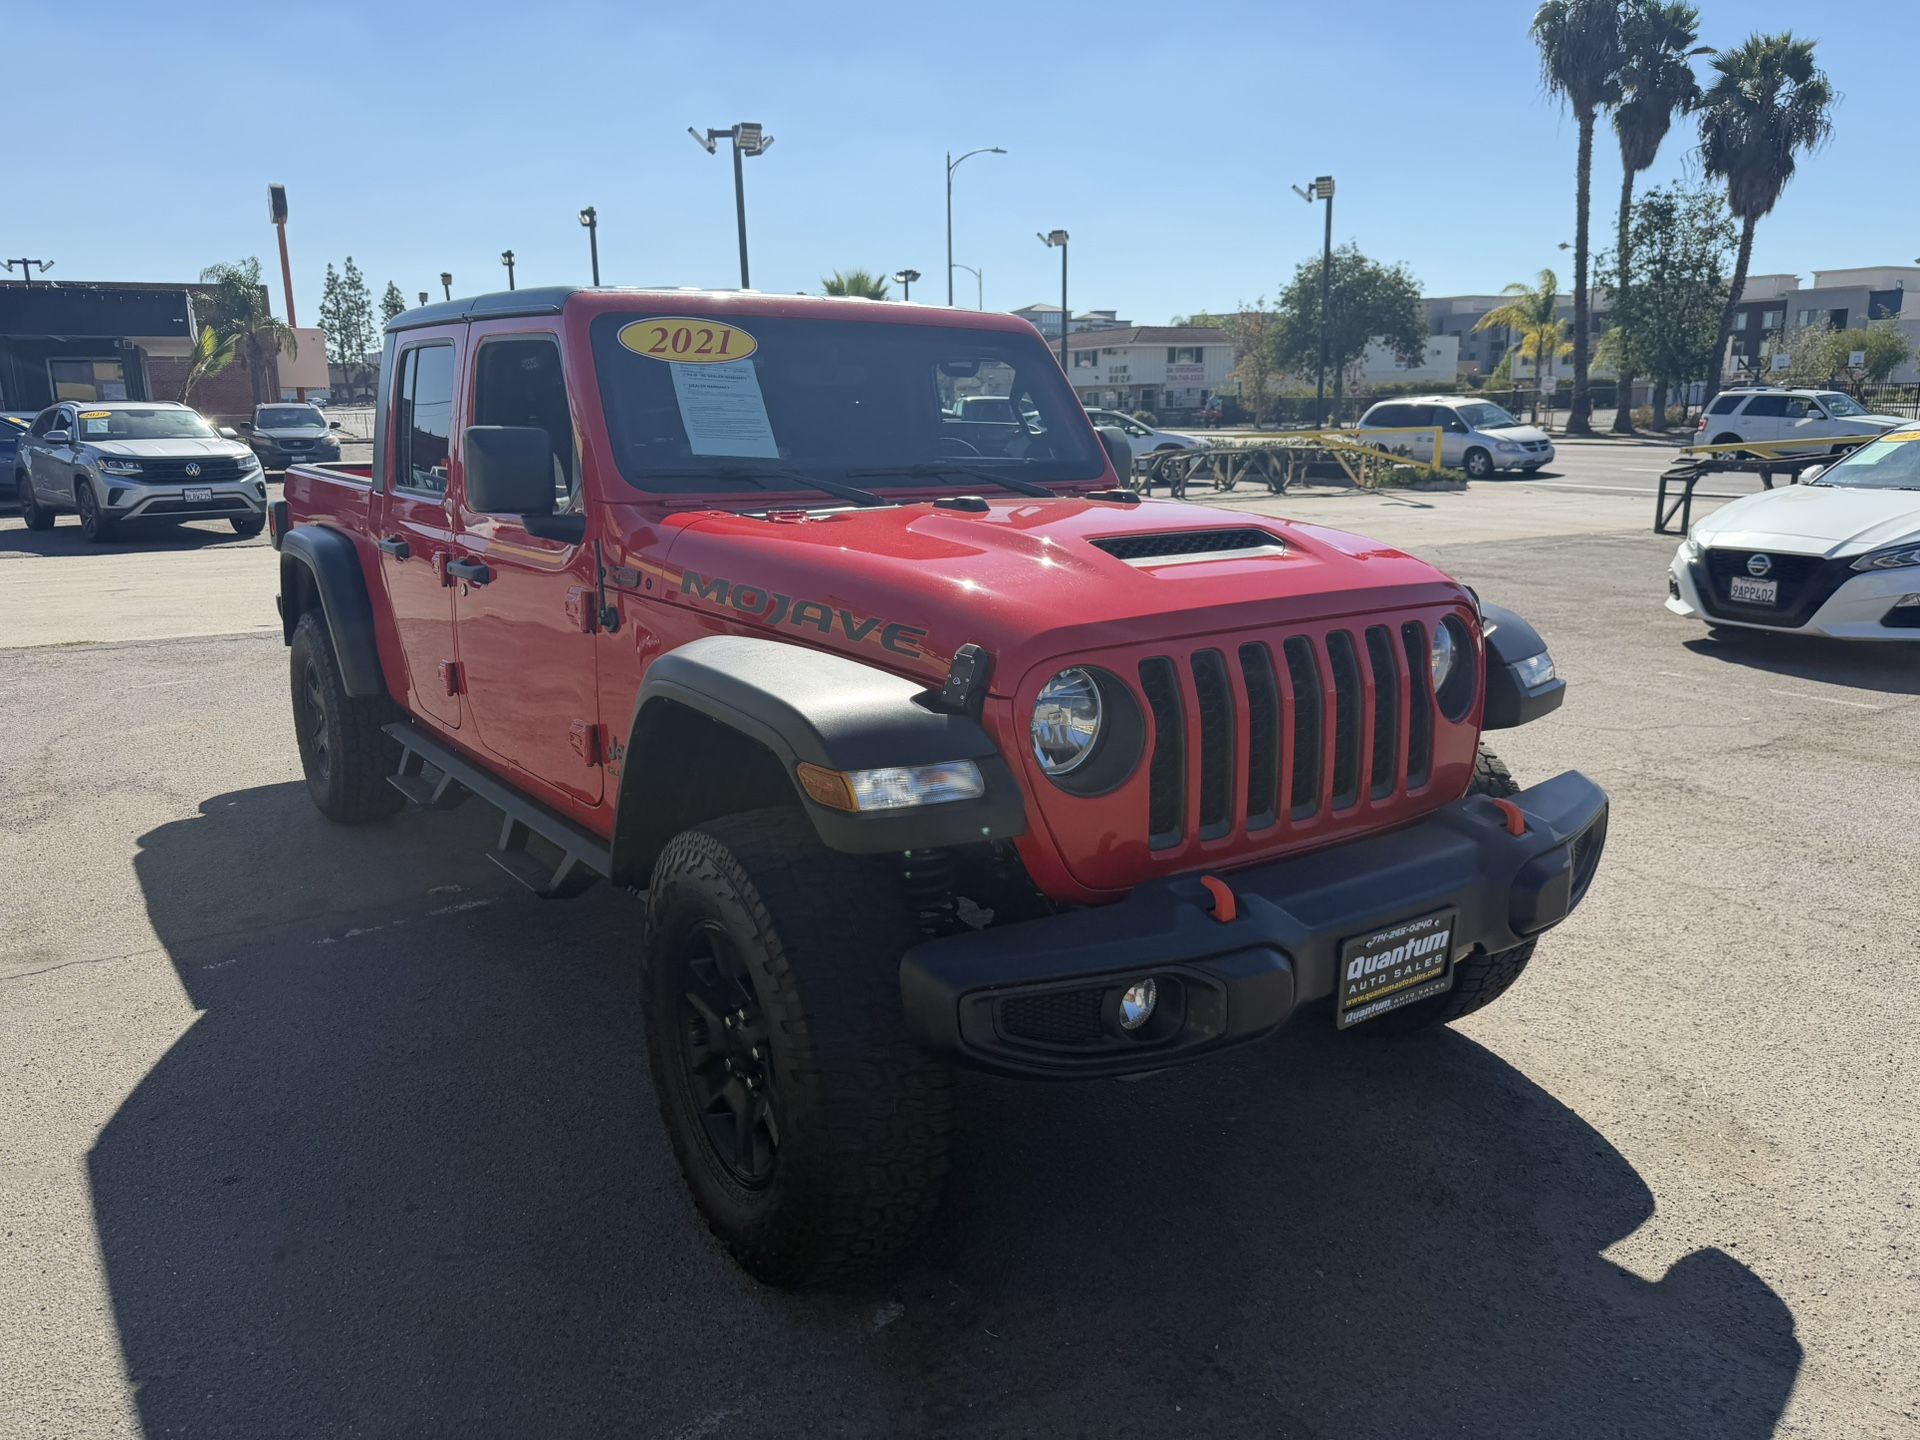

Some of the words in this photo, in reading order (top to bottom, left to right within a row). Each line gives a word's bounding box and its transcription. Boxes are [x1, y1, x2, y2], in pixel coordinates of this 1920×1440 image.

[647, 327, 732, 354] 2021
[681, 569, 928, 658] MOJAVE
[1732, 585, 1774, 603] 9APP402
[1347, 930, 1450, 981] Quantum
[1349, 974, 1387, 994] AUTO
[1394, 954, 1443, 978] SALES
[1346, 967, 1441, 1006] www.quantumautosales.com
[1344, 999, 1392, 1023] Quantum
